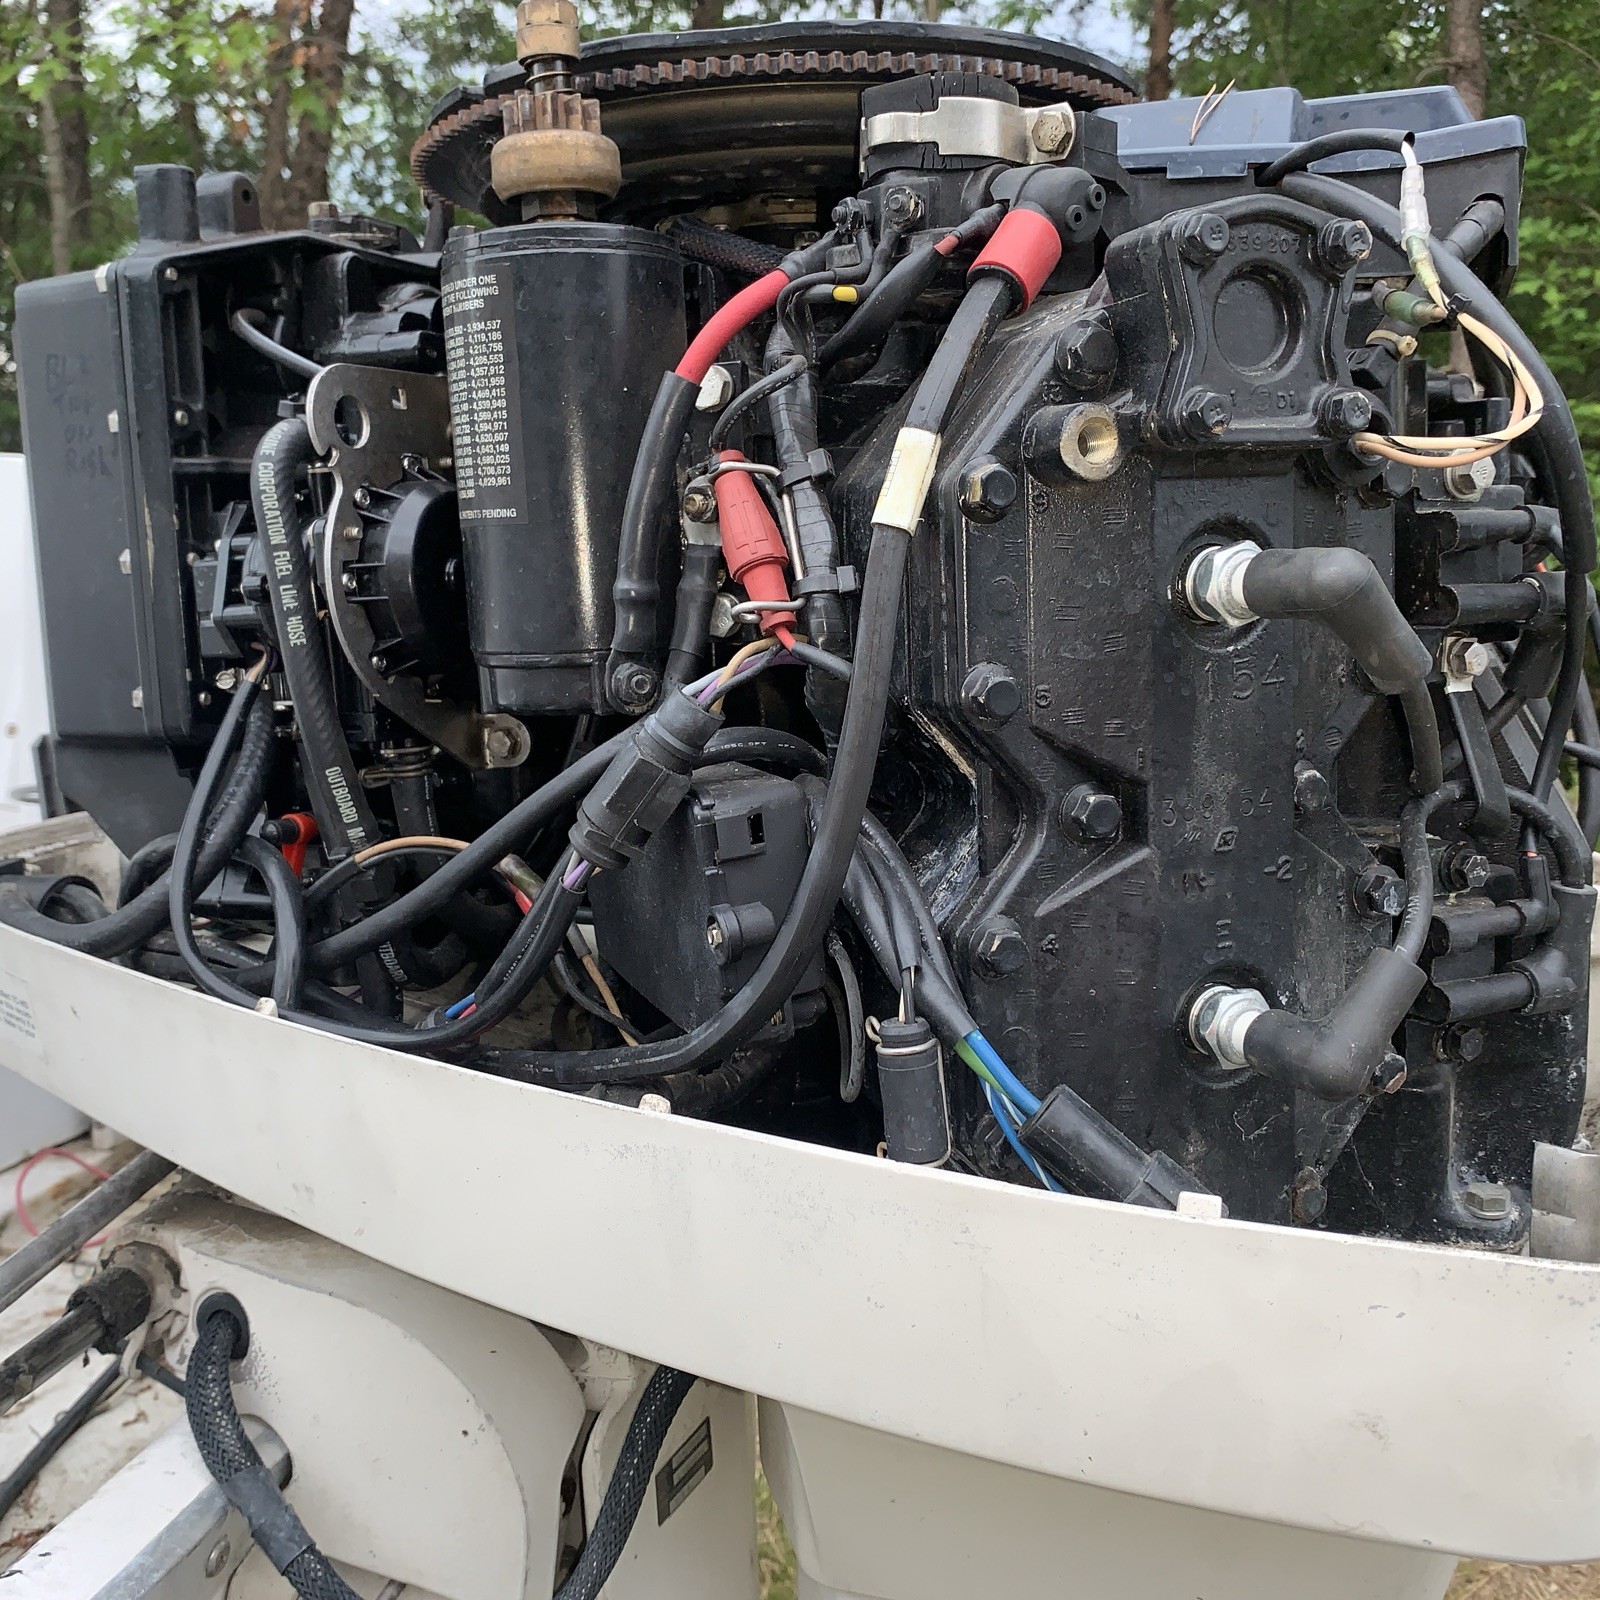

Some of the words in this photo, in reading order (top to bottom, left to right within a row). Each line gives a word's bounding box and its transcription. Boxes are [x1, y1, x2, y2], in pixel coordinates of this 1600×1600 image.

[455, 277, 477, 290] UNDER
[478, 274, 497, 285] ONE
[456, 286, 499, 301] FOLLOWING
[467, 319, 501, 333] 3,934,537
[469, 331, 502, 344] 4,119,186
[469, 342, 503, 355] 4,216,756
[471, 365, 505, 378] 4,357,912
[472, 376, 505, 389] 4,431,959
[473, 398, 507, 412] 4,539,949
[475, 421, 508, 433] 4,594,971
[476, 443, 510, 455] 4,643,149
[258, 461, 288, 546] CORPORATION
[482, 508, 517, 519] PENDING
[272, 549, 293, 580] FUEL
[279, 583, 298, 612] LINE
[286, 615, 307, 648] HOSE
[325, 765, 359, 824] OUTBOARD
